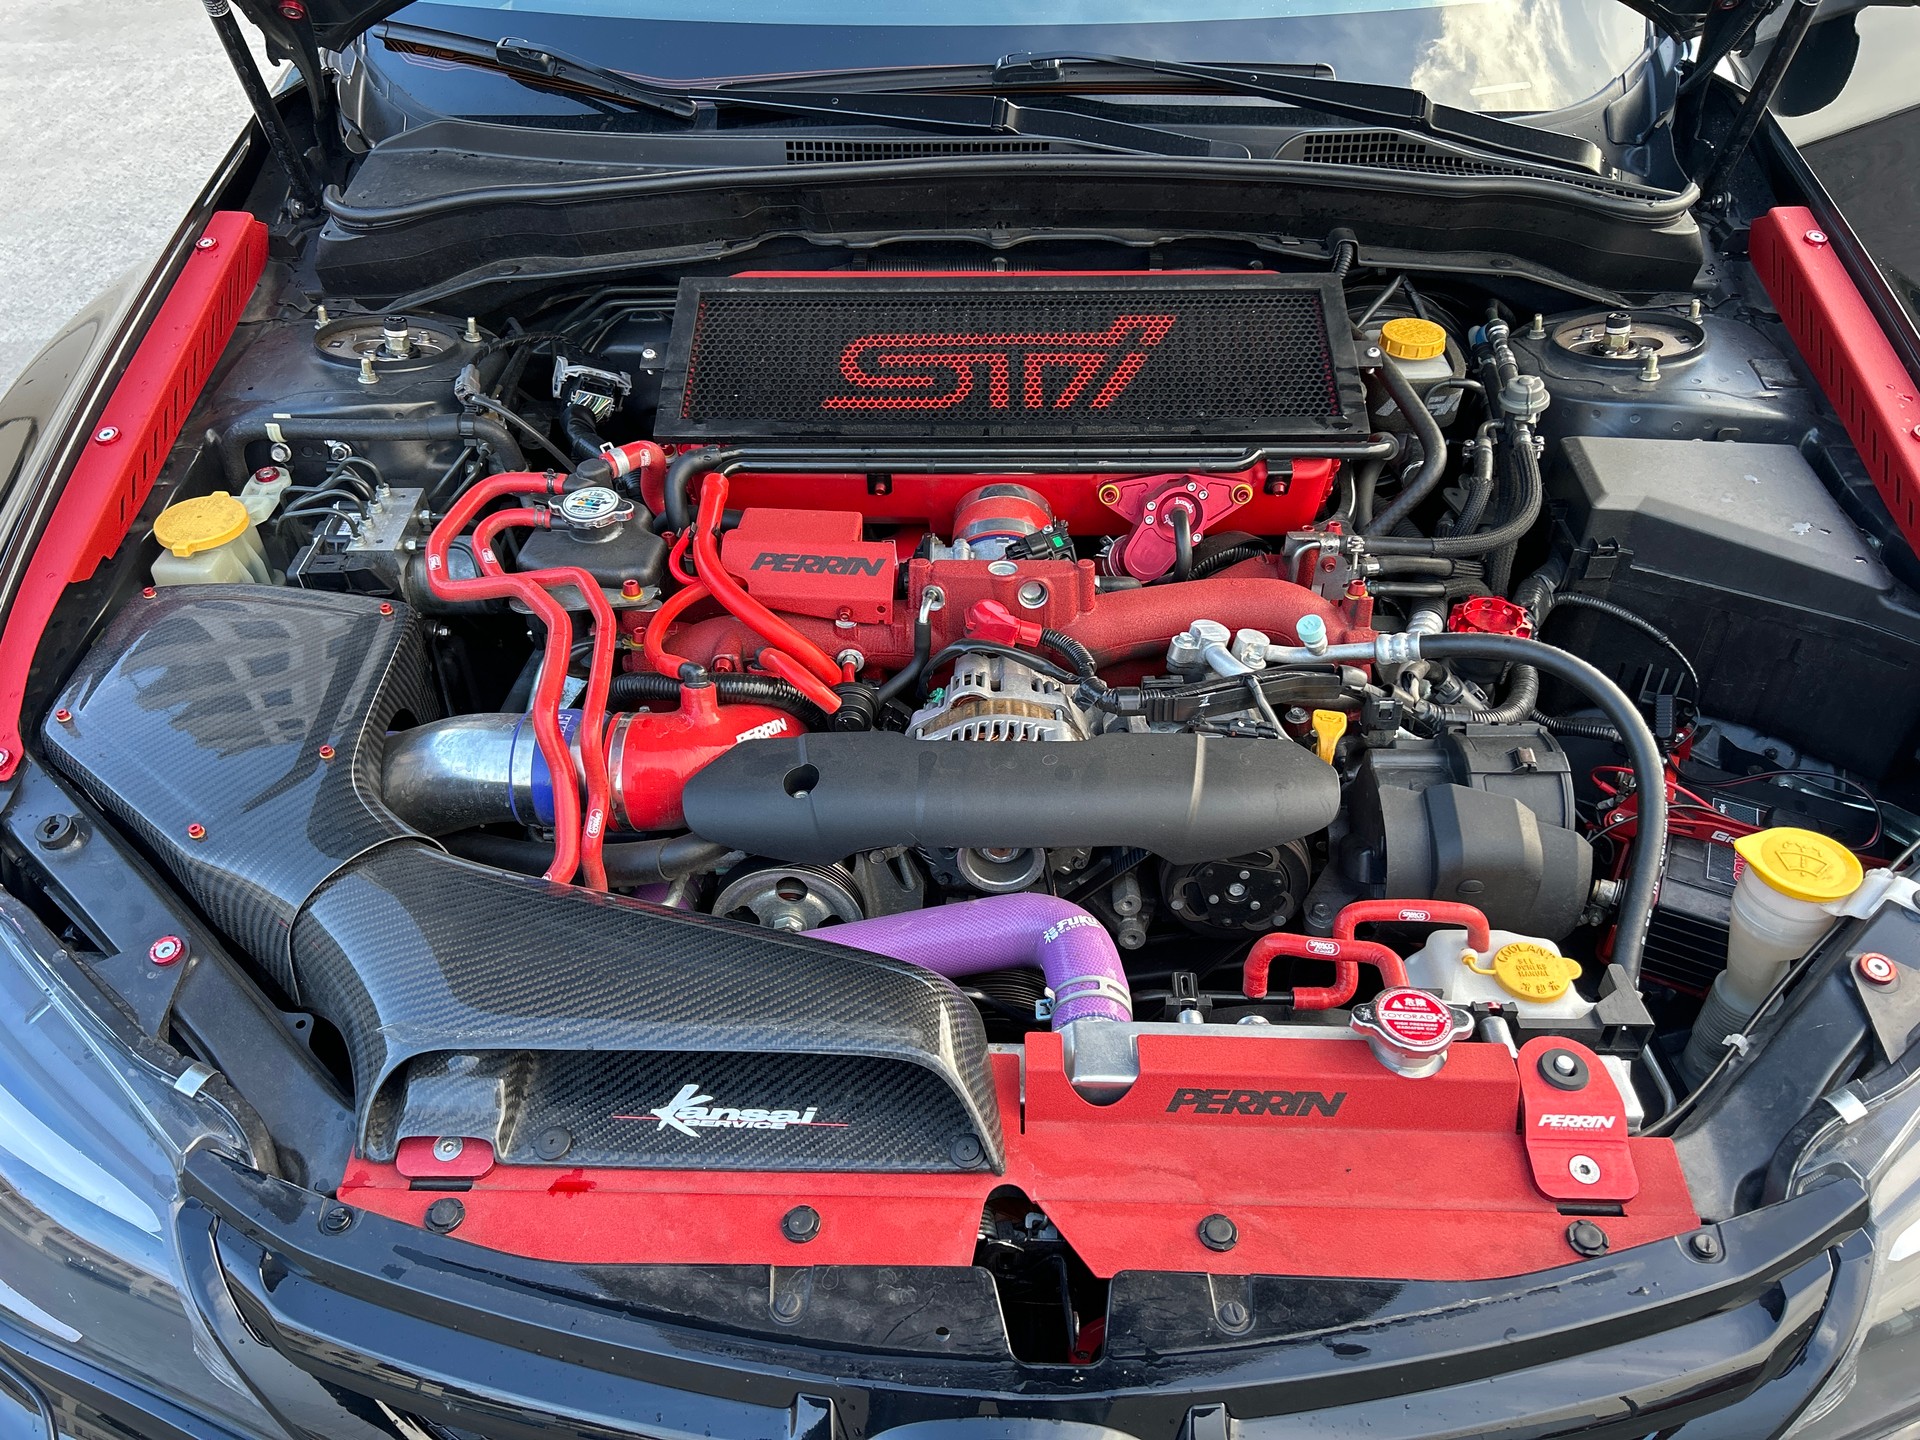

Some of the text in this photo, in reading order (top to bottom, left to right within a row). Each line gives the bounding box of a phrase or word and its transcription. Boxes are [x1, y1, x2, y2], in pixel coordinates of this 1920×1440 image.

[750, 552, 887, 577] PERRIN
[1497, 944, 1556, 963] COOLANT
[1381, 1012, 1435, 1020] KOYORAD
[650, 1084, 818, 1138] Kansai
[1165, 1088, 1348, 1117] PERRIN
[683, 1119, 788, 1130] SERVICE
[1538, 1114, 1616, 1128] PERRIN
